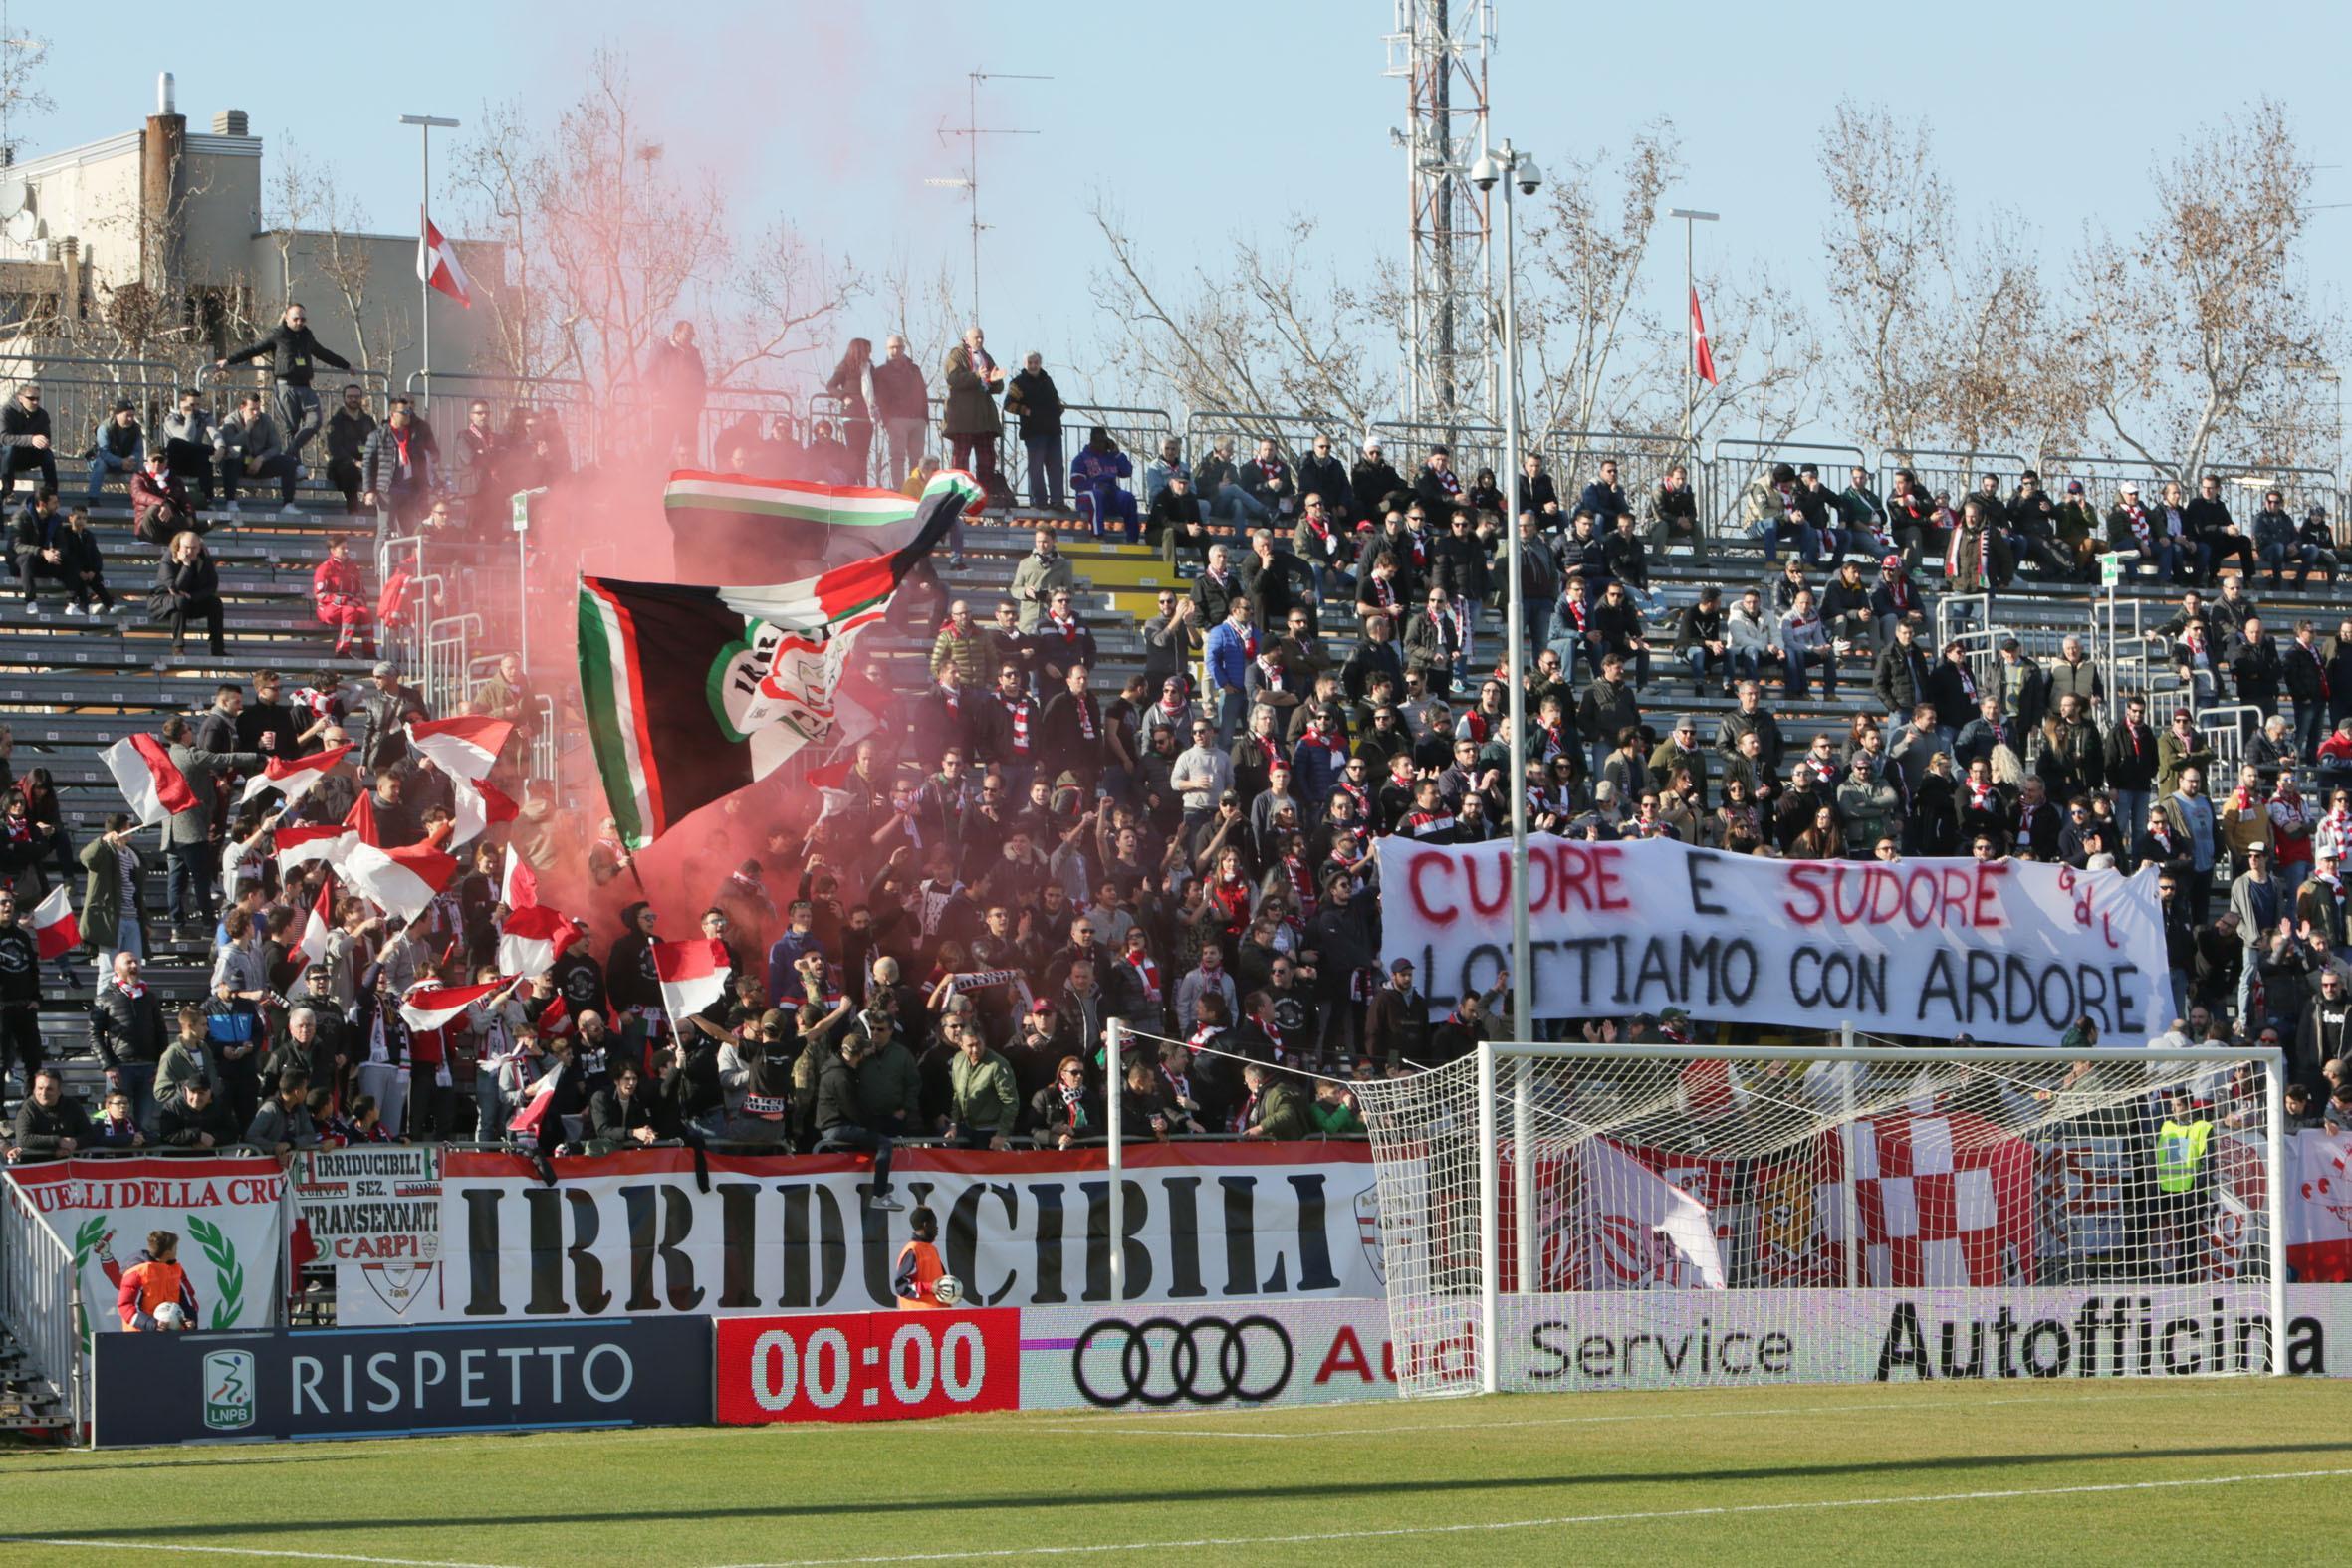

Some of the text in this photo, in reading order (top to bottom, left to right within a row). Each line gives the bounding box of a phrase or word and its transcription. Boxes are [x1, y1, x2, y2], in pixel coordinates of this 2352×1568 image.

[1409, 845, 2009, 929] CUORE E SUDORE
[1423, 931, 2146, 1034] LOTTIAMO CON ARDORE
[316, 1153, 421, 1178] IRRIDUCIBILI
[356, 1181, 387, 1197] SEZ.
[118, 1180, 222, 1209] DELLA
[301, 1201, 439, 1235] TRANSENNATI
[335, 1234, 418, 1259] CARPI
[463, 1173, 1341, 1316] IRRIDUCIBILI
[751, 1322, 986, 1412] 00:00
[1314, 1296, 2327, 1385] Aud Service Autofficina
[292, 1342, 634, 1415] RISPETTO
[211, 1408, 248, 1423] LNPB
